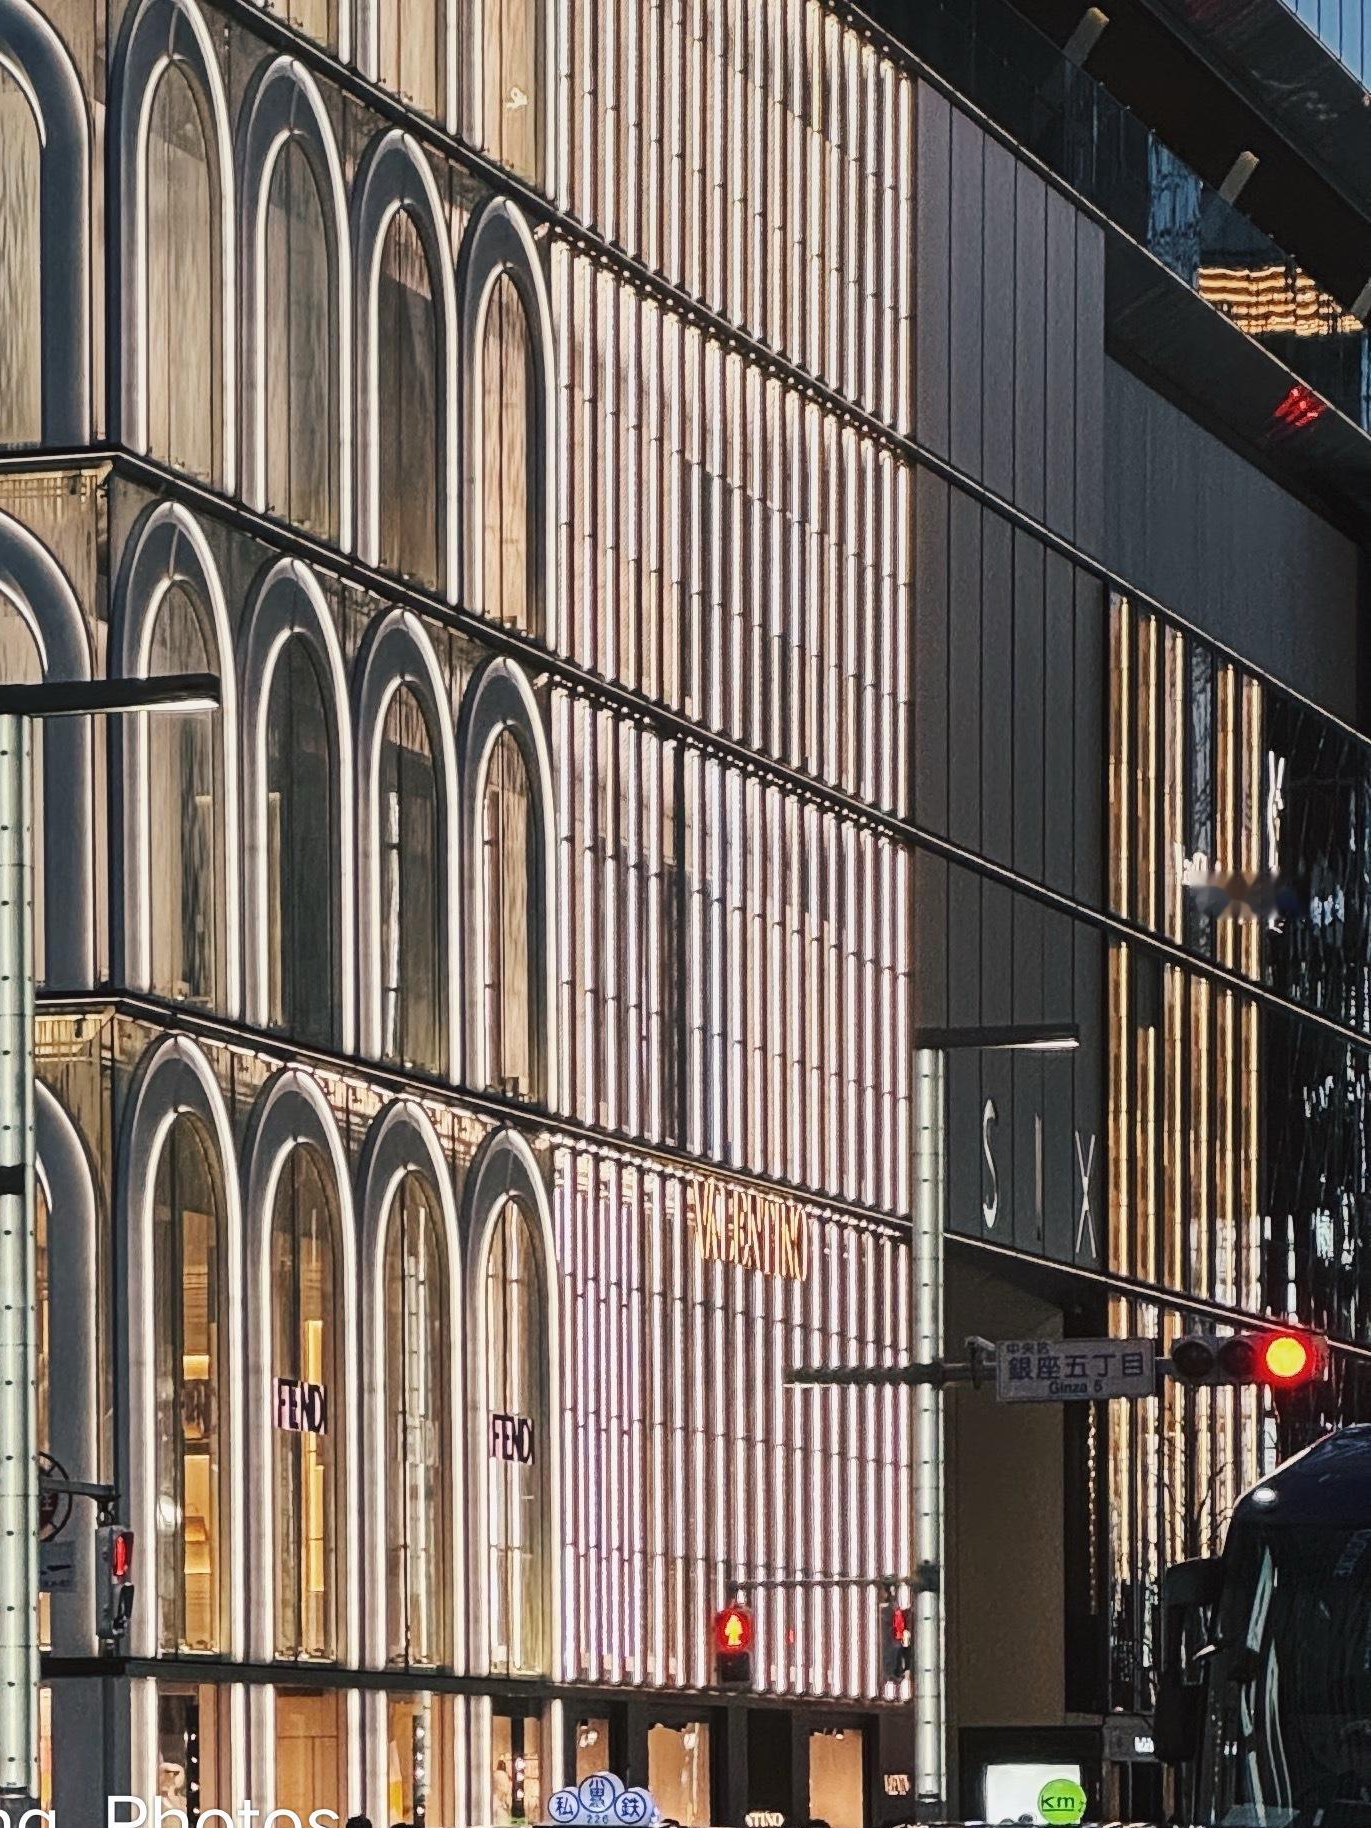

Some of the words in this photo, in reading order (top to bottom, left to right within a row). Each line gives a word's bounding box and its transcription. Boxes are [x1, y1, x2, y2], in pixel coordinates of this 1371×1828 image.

[1008, 1352, 1144, 1380] 銀座五丁目
[277, 1377, 328, 1435] FENDI
[1049, 1381, 1088, 1395] Ginza
[492, 1413, 536, 1465] FENDI
